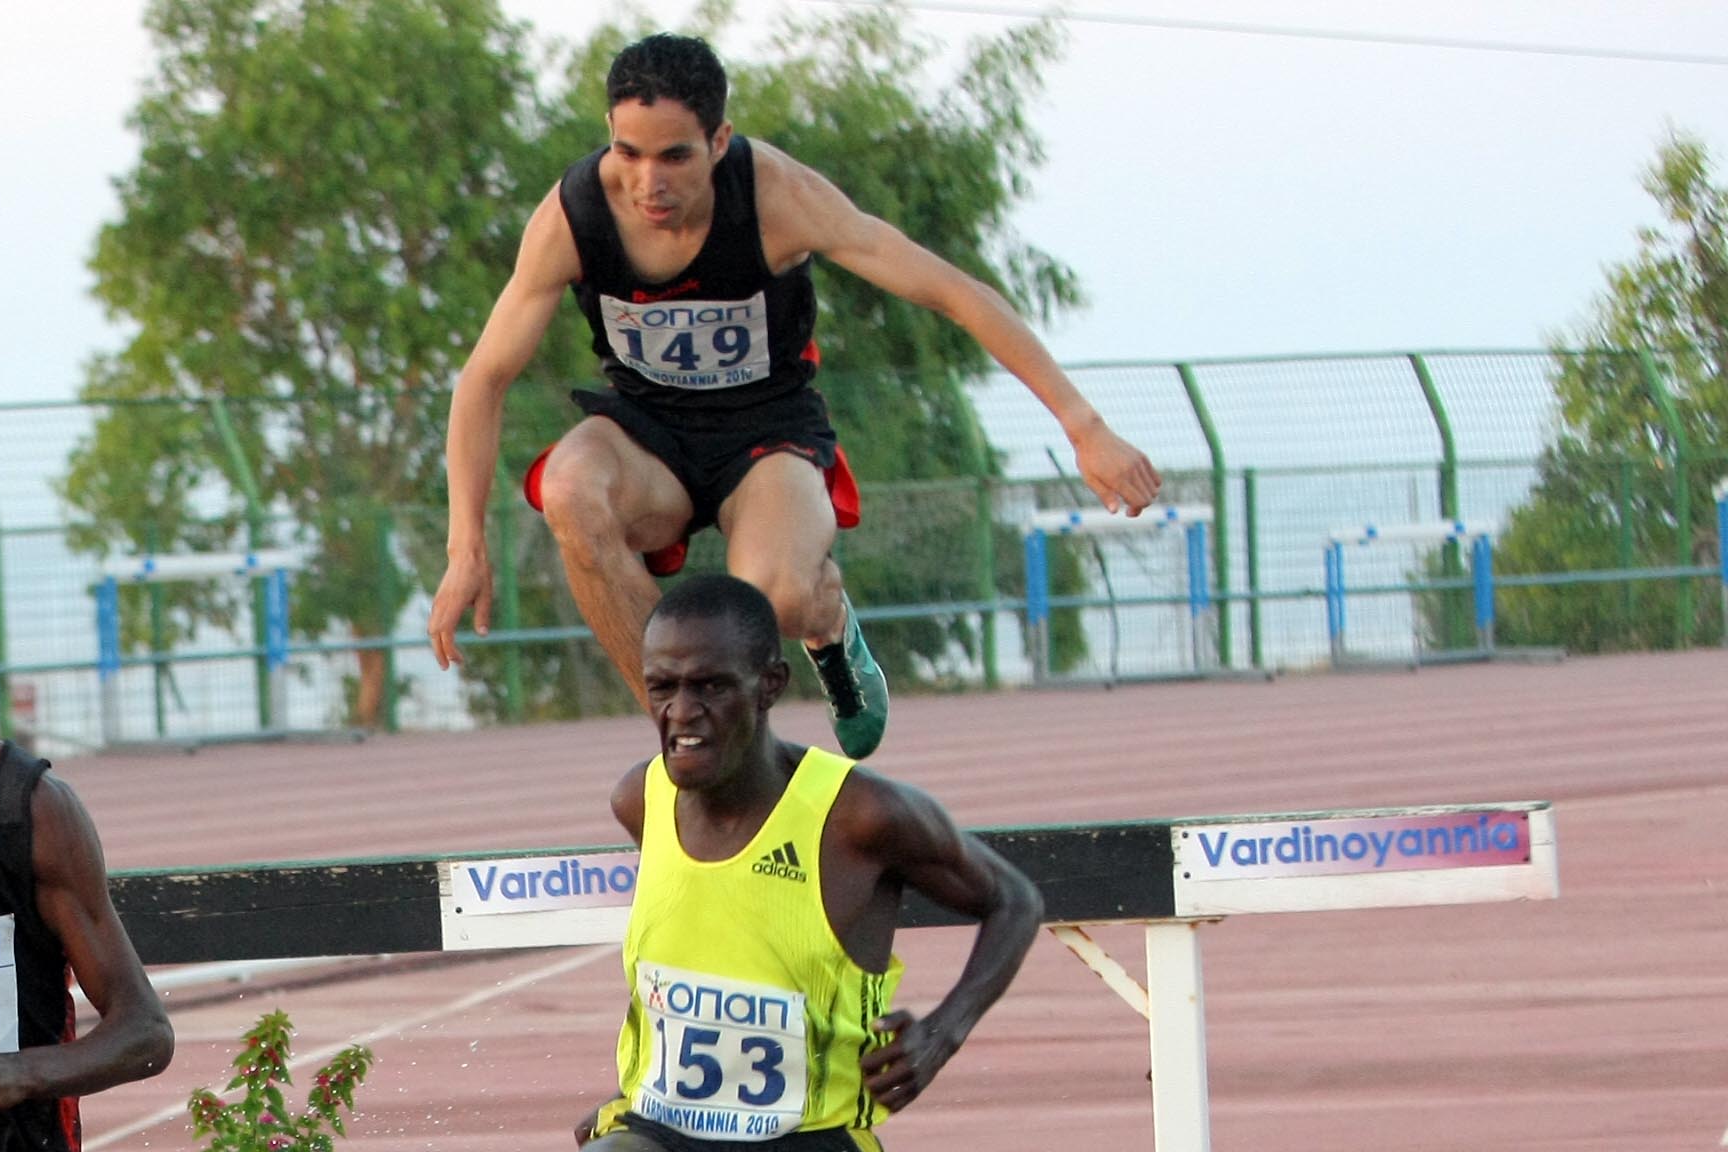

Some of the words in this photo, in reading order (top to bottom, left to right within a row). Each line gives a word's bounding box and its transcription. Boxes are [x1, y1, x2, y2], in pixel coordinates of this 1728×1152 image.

[618, 325, 751, 371] 149
[1198, 814, 1519, 868] Vardinoyannia
[467, 858, 639, 902] Vardino
[751, 861, 807, 885] adidas
[653, 1017, 787, 1108] 153
[745, 1114, 780, 1135] 2010
